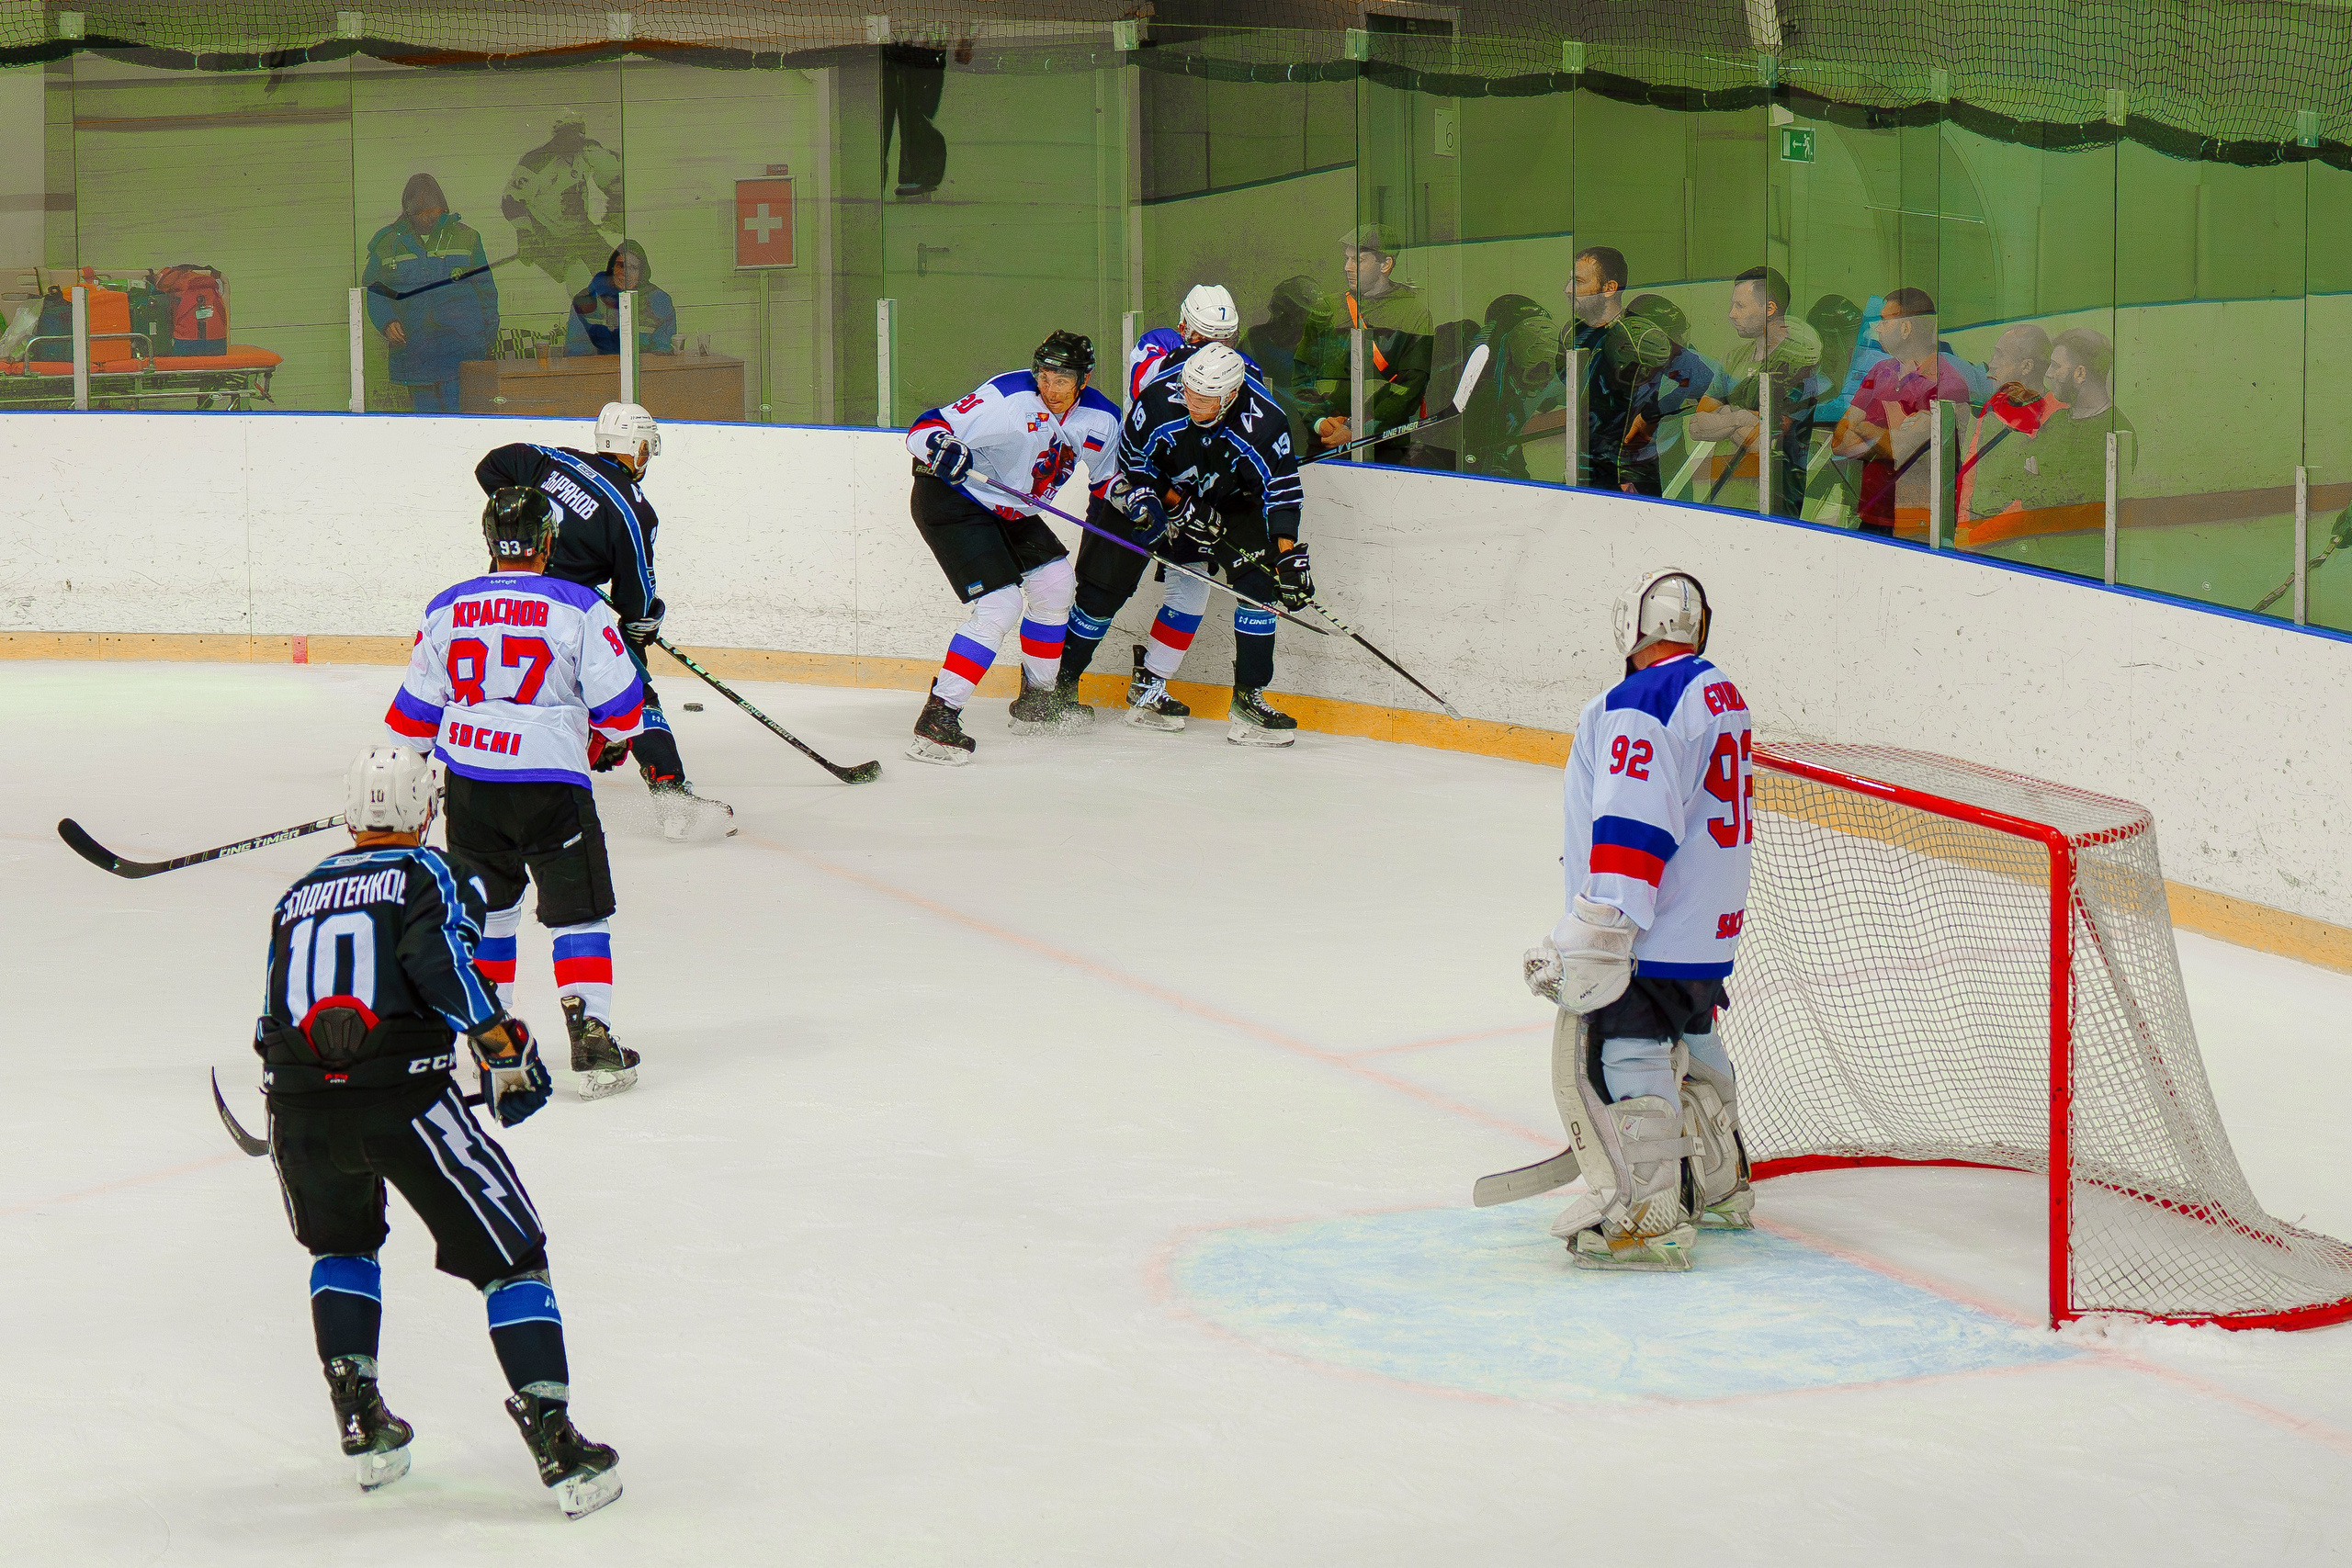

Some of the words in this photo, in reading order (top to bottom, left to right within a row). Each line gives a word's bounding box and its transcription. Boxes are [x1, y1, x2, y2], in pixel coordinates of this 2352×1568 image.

[1218, 307, 1227, 320] 7
[1397, 421, 1419, 434] TIMER
[605, 439, 611, 448] 8
[1272, 432, 1291, 457] 19
[499, 540, 522, 556] 93
[452, 598, 548, 629] КРАСНОВ
[446, 633, 556, 707] 87
[448, 721, 522, 756] SOCHI
[1610, 735, 1654, 781] 92
[369, 789, 385, 804] 10
[1703, 728, 1753, 850] 9
[219, 841, 252, 859] ONE
[254, 829, 300, 850] TIMER
[286, 910, 376, 1027] 10
